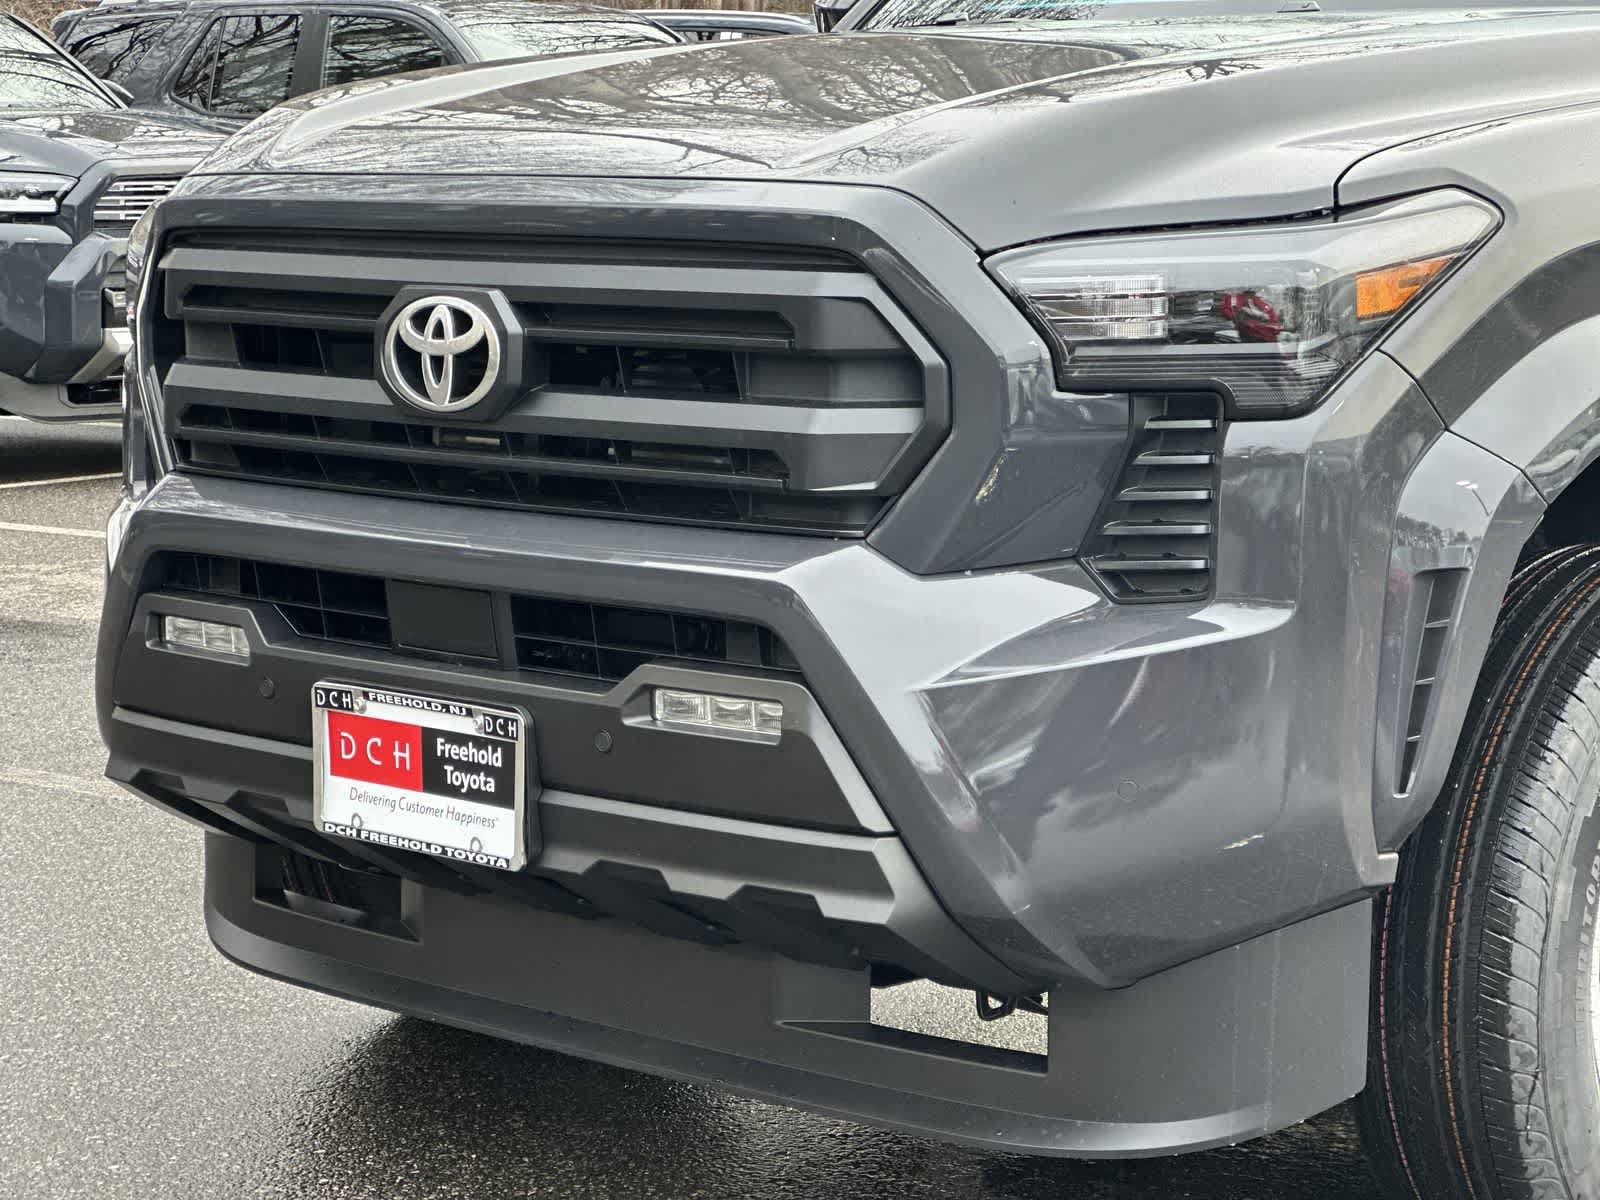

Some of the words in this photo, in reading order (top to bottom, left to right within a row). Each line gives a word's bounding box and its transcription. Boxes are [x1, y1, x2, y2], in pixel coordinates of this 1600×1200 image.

[316, 690, 353, 710] DCH
[368, 692, 447, 713] FREEHOLD,
[449, 705, 468, 716] NJ
[485, 716, 517, 738] DCH
[340, 731, 411, 771] DCH
[436, 737, 502, 768] Freehold
[443, 765, 496, 793] Toyota
[349, 786, 397, 813] Delivering
[398, 796, 445, 818] Customer
[324, 822, 358, 838] DCH
[360, 830, 443, 854] FREEHOLD
[444, 846, 508, 868] TOYOTA
